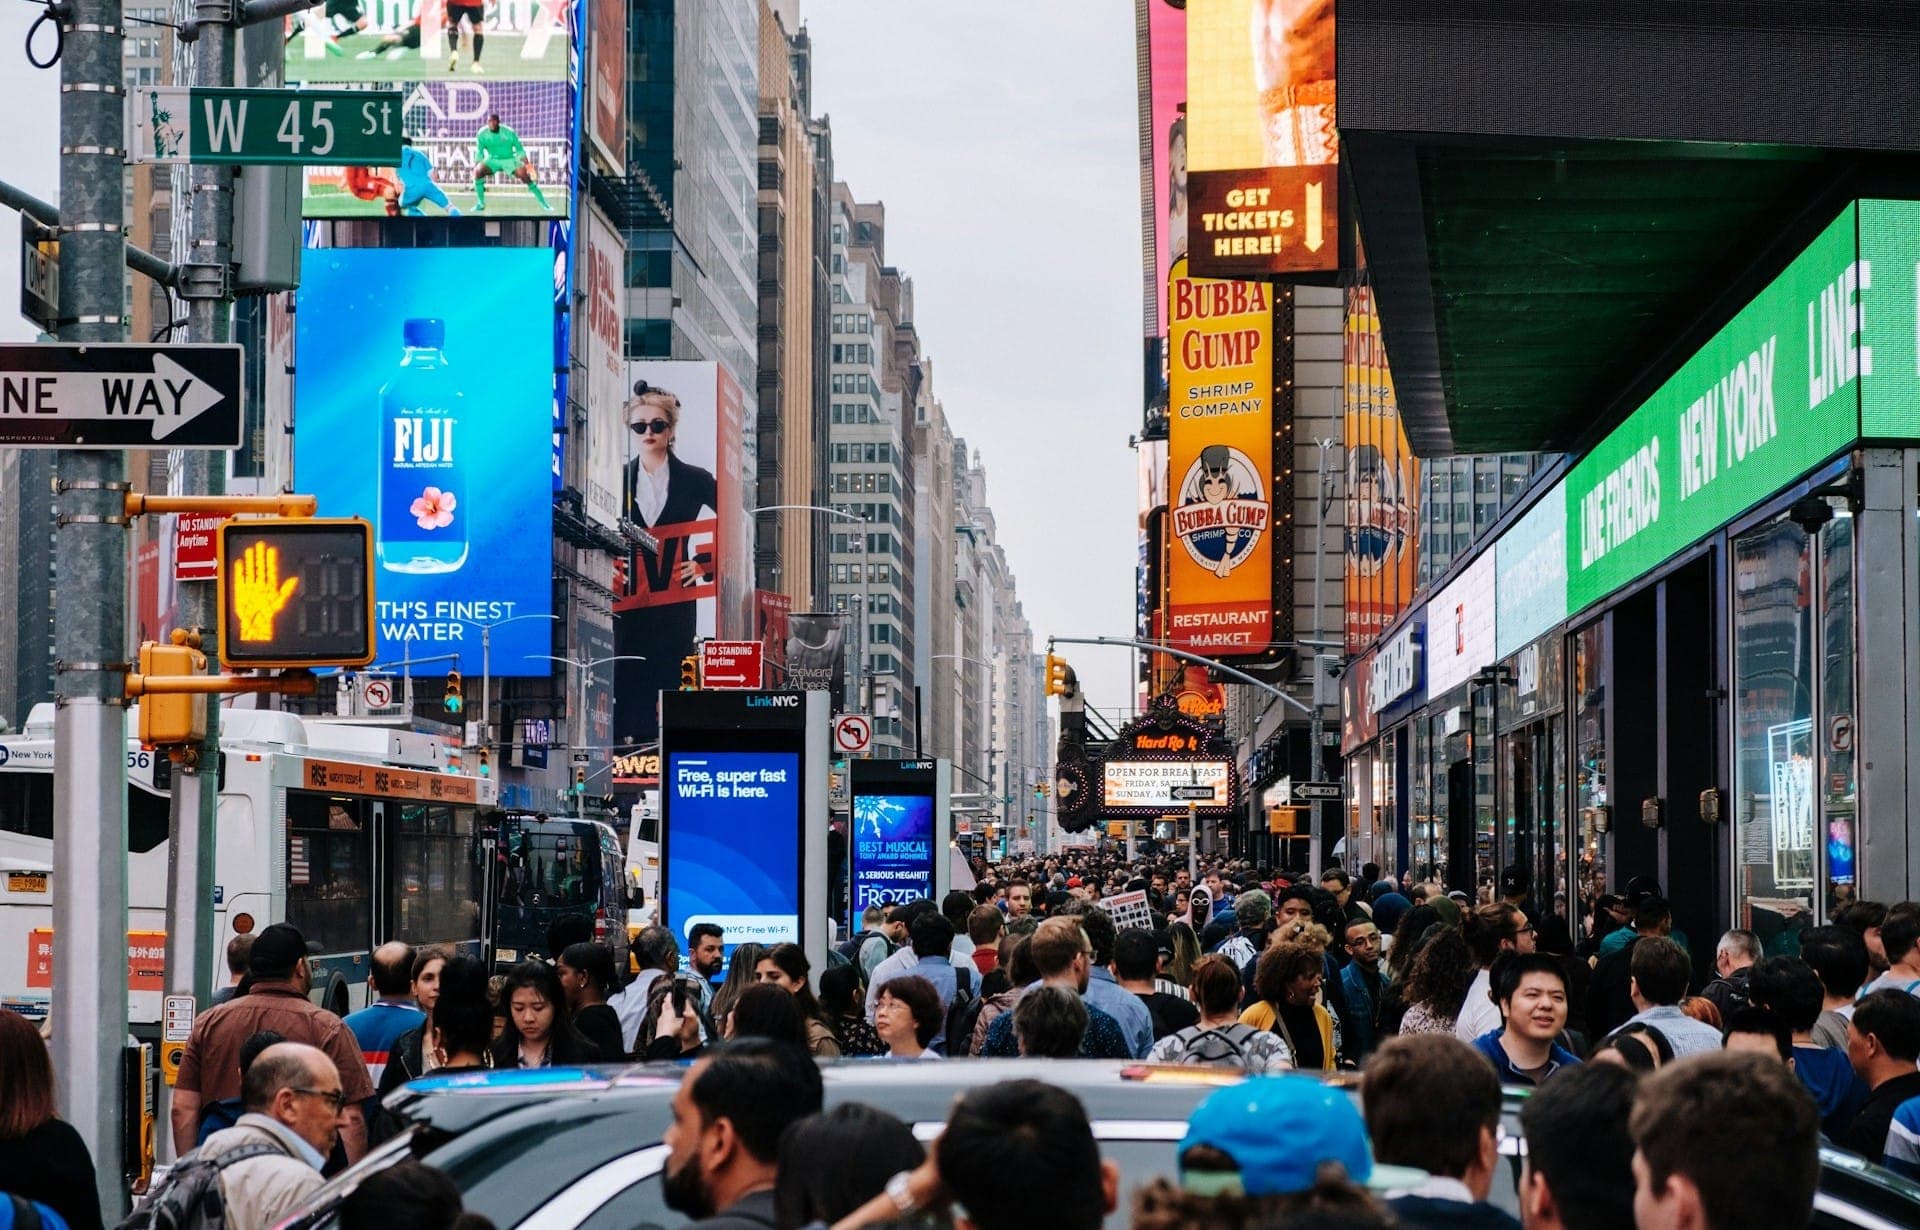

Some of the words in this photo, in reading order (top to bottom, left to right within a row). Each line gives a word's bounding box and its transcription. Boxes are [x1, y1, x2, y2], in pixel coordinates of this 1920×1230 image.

[205, 99, 248, 153] W
[277, 101, 335, 156] 45
[361, 101, 392, 136] St
[1226, 187, 1271, 209] GET
[1202, 210, 1294, 232] TICKETS
[1214, 235, 1282, 256] HERE!
[1175, 278, 1268, 320] BUBBA
[1182, 329, 1261, 371] GUMP
[3, 376, 58, 415] NE
[102, 378, 193, 416] WAY
[1189, 381, 1254, 400] SHRIMP
[1180, 399, 1262, 418] COMPANY
[1604, 435, 1660, 550] FRIENDS
[1680, 382, 1720, 502] NEW
[1720, 333, 1777, 470] YORK
[1807, 260, 1872, 411] LINE
[393, 417, 453, 462] FIJI
[180, 519, 191, 532] NO
[1176, 507, 1224, 533] BUBBA
[1226, 502, 1266, 527] GUMP
[180, 534, 209, 549] Anytime
[1192, 529, 1225, 543] SHRIMP
[377, 601, 428, 620] TH'S
[435, 601, 517, 620] FINEST
[1173, 610, 1269, 628] RESTAURANT
[381, 622, 464, 641] WATER
[1190, 632, 1252, 648] MARKET
[706, 646, 718, 656] NO
[718, 646, 753, 656] STANDING
[706, 657, 736, 668] Anytime
[788, 663, 833, 678] Edward
[746, 695, 799, 707] LinkNYC
[1136, 736, 1168, 749] Hard
[1168, 735, 1197, 752] Rok
[11, 751, 31, 759] New
[33, 751, 53, 760] York
[128, 752, 150, 769] 56
[900, 761, 933, 769] LinkNYC
[311, 763, 328, 787] RISE
[375, 771, 389, 793] RISE
[430, 777, 442, 798] RISE
[678, 768, 713, 785] Free,
[716, 771, 758, 785] super
[759, 768, 787, 783] fast
[1107, 768, 1136, 777] OPEN
[1140, 768, 1160, 777] FOR
[678, 784, 714, 798] Wi-Fi
[717, 784, 730, 798] is
[733, 784, 769, 798] here.
[1298, 787, 1313, 795] ONE
[1320, 787, 1336, 795] WAY
[859, 841, 883, 853] BEST
[885, 841, 929, 853] MUSICAL
[865, 871, 895, 880] SERIOUS
[858, 884, 929, 909] FROZEN
[746, 926, 766, 934] Free
[767, 926, 789, 934] Wi-Fi
